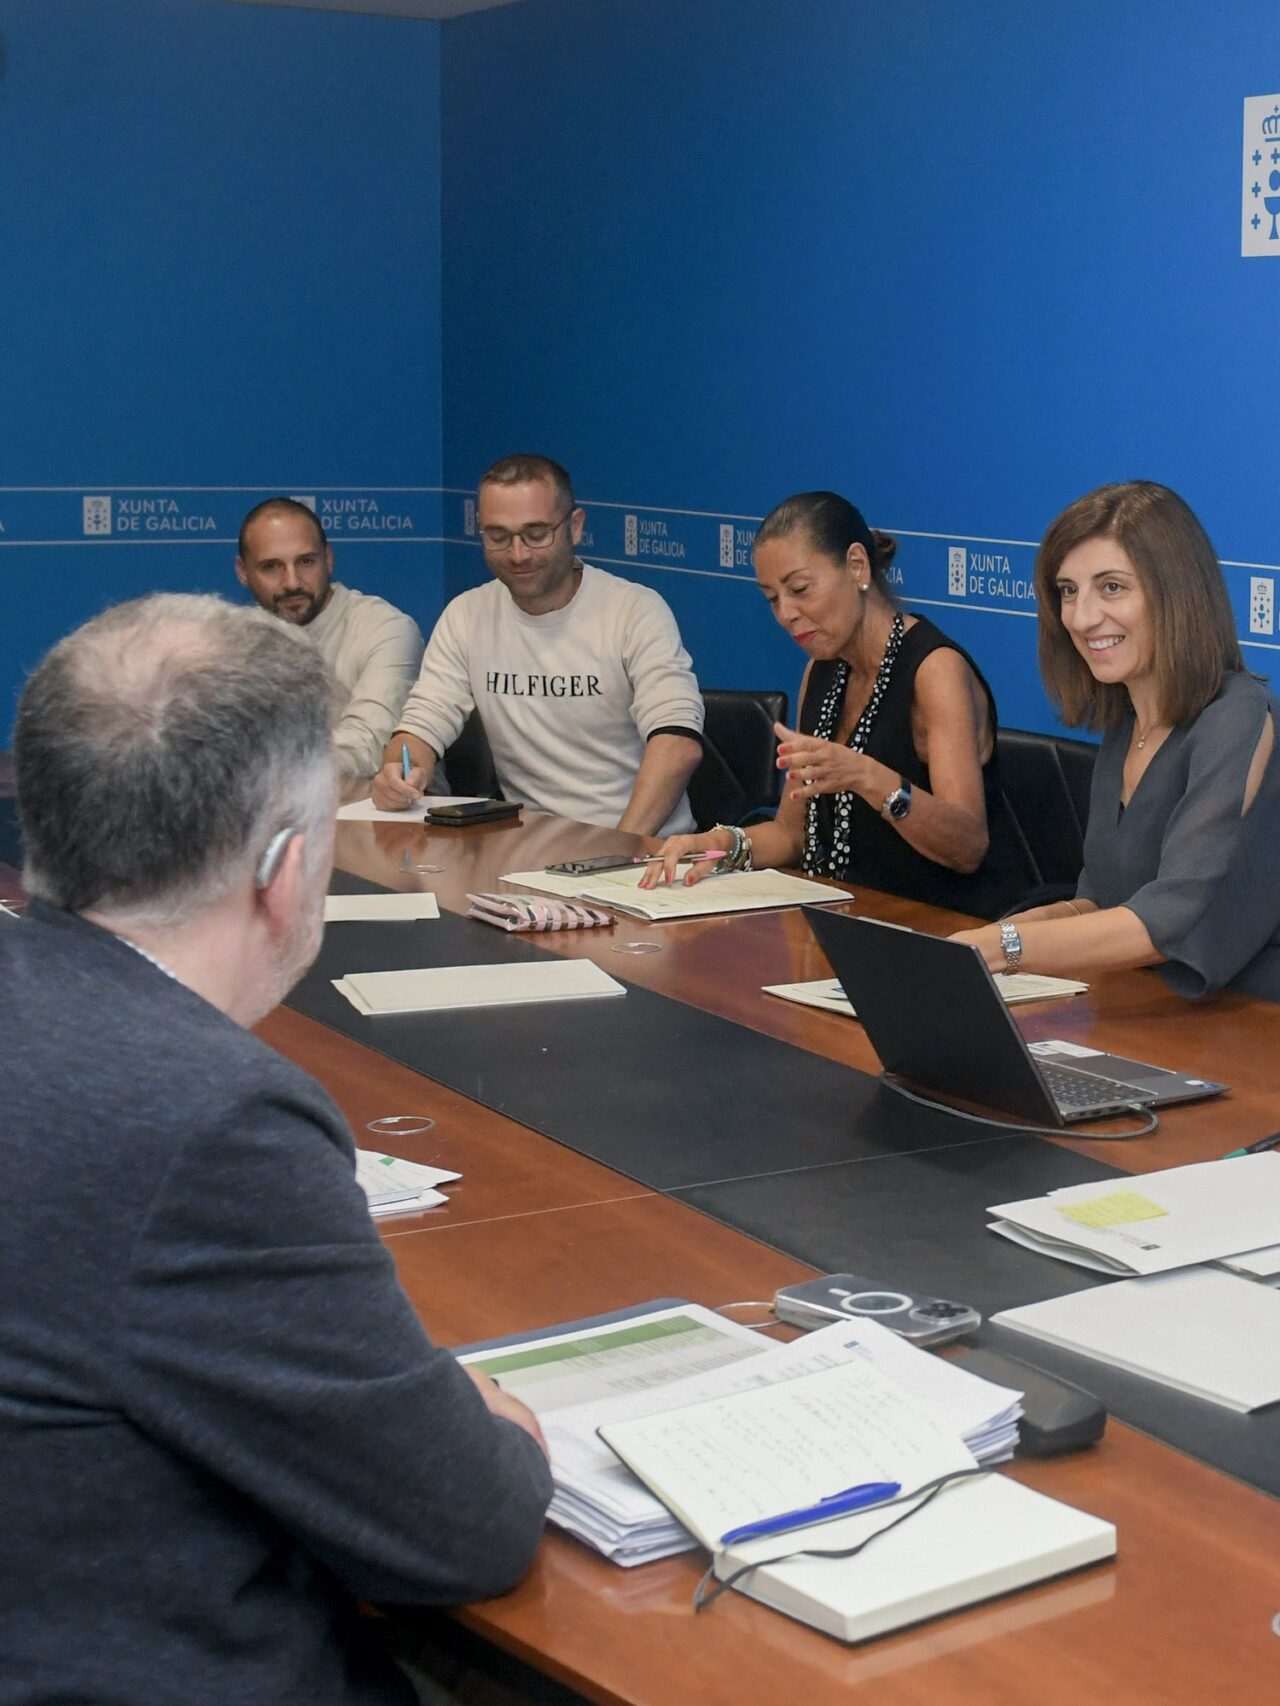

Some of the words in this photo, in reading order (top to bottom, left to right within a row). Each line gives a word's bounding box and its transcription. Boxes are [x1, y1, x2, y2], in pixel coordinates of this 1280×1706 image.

[118, 499, 180, 514] XUNTA
[322, 499, 379, 513] XUNTA
[117, 516, 140, 532] DE
[145, 516, 217, 532] GALICIA
[321, 516, 343, 530] DE
[347, 515, 414, 530] GALICIA
[639, 520, 668, 537] XUNTA
[735, 529, 756, 547] XUN
[639, 538, 651, 555] DE
[652, 539, 686, 558] GALICIA
[735, 548, 749, 567] DE
[970, 553, 1011, 574] XUNTA
[969, 576, 985, 595] DE
[988, 577, 1036, 600] GALICIA
[486, 671, 605, 698] HILFIGER
